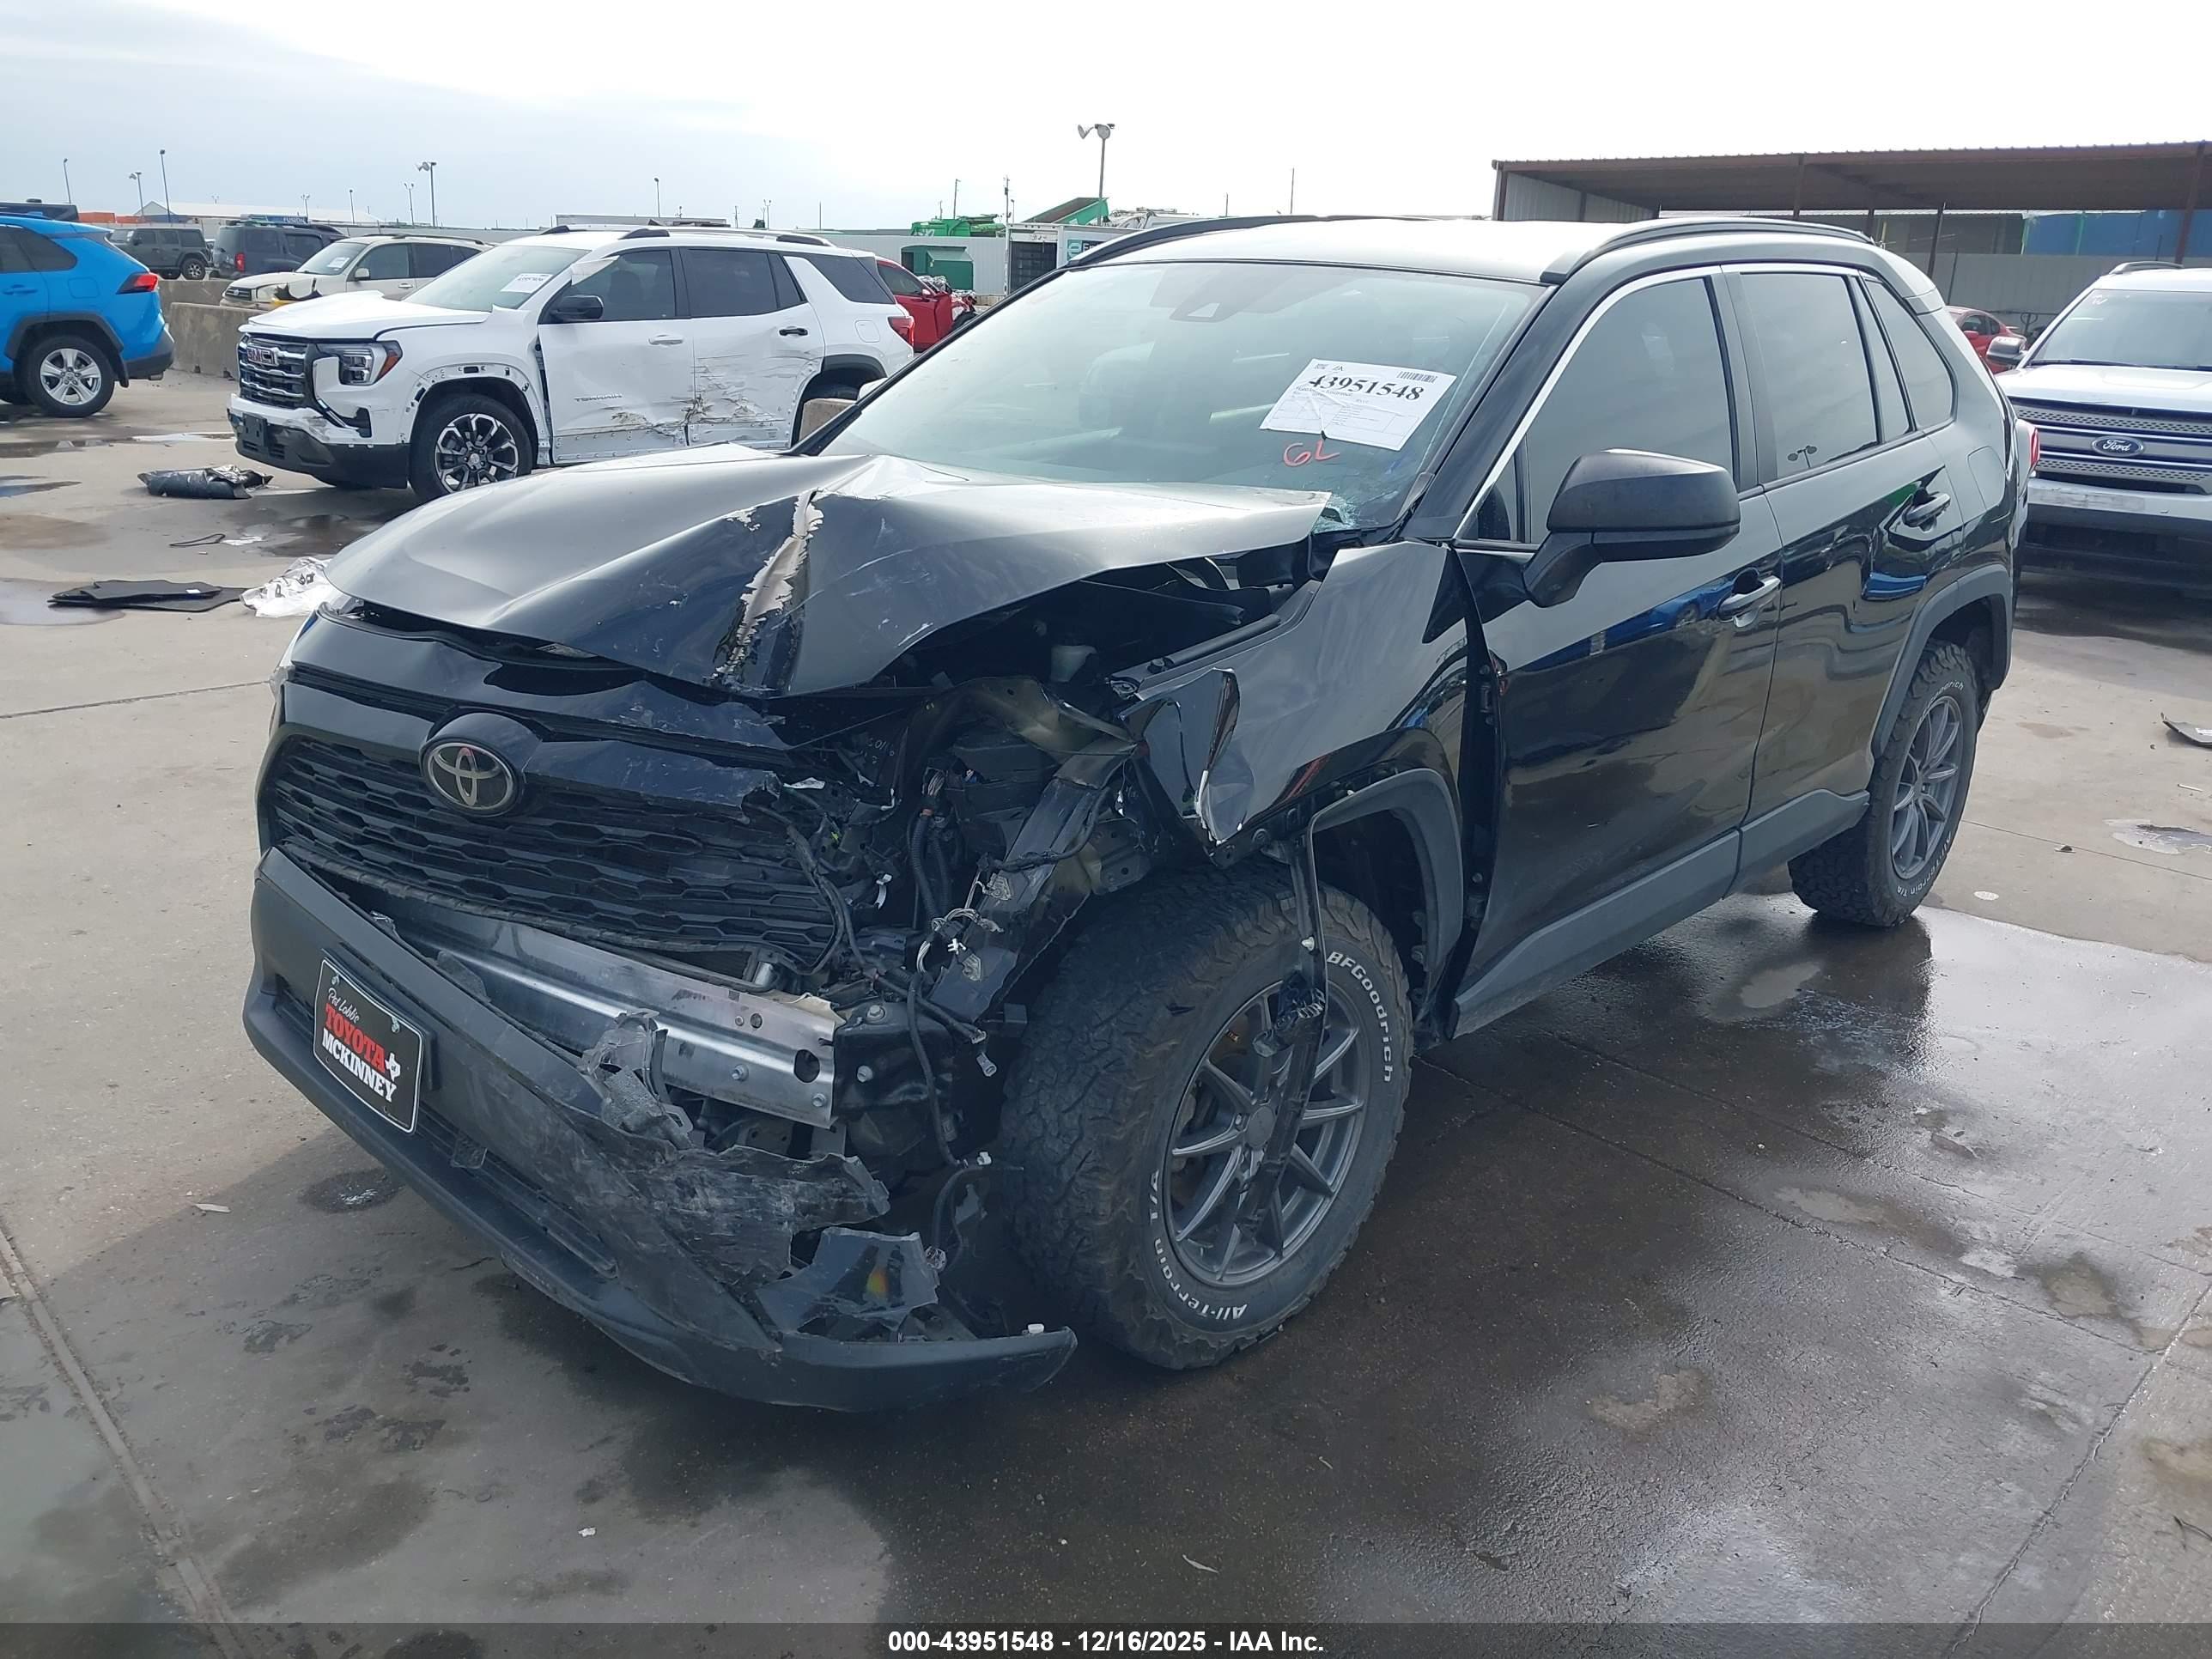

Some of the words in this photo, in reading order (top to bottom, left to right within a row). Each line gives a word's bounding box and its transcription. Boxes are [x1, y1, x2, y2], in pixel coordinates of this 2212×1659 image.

[247, 348, 276, 365] GMC
[1309, 375, 1425, 401] 43951548
[2103, 439, 2132, 451] Ford
[325, 1003, 386, 1073] TOYOTA
[1326, 951, 1393, 1082] BFGoodrich
[322, 1027, 398, 1103] MCKINNEY
[1154, 1238, 1248, 1321] All-Terrain
